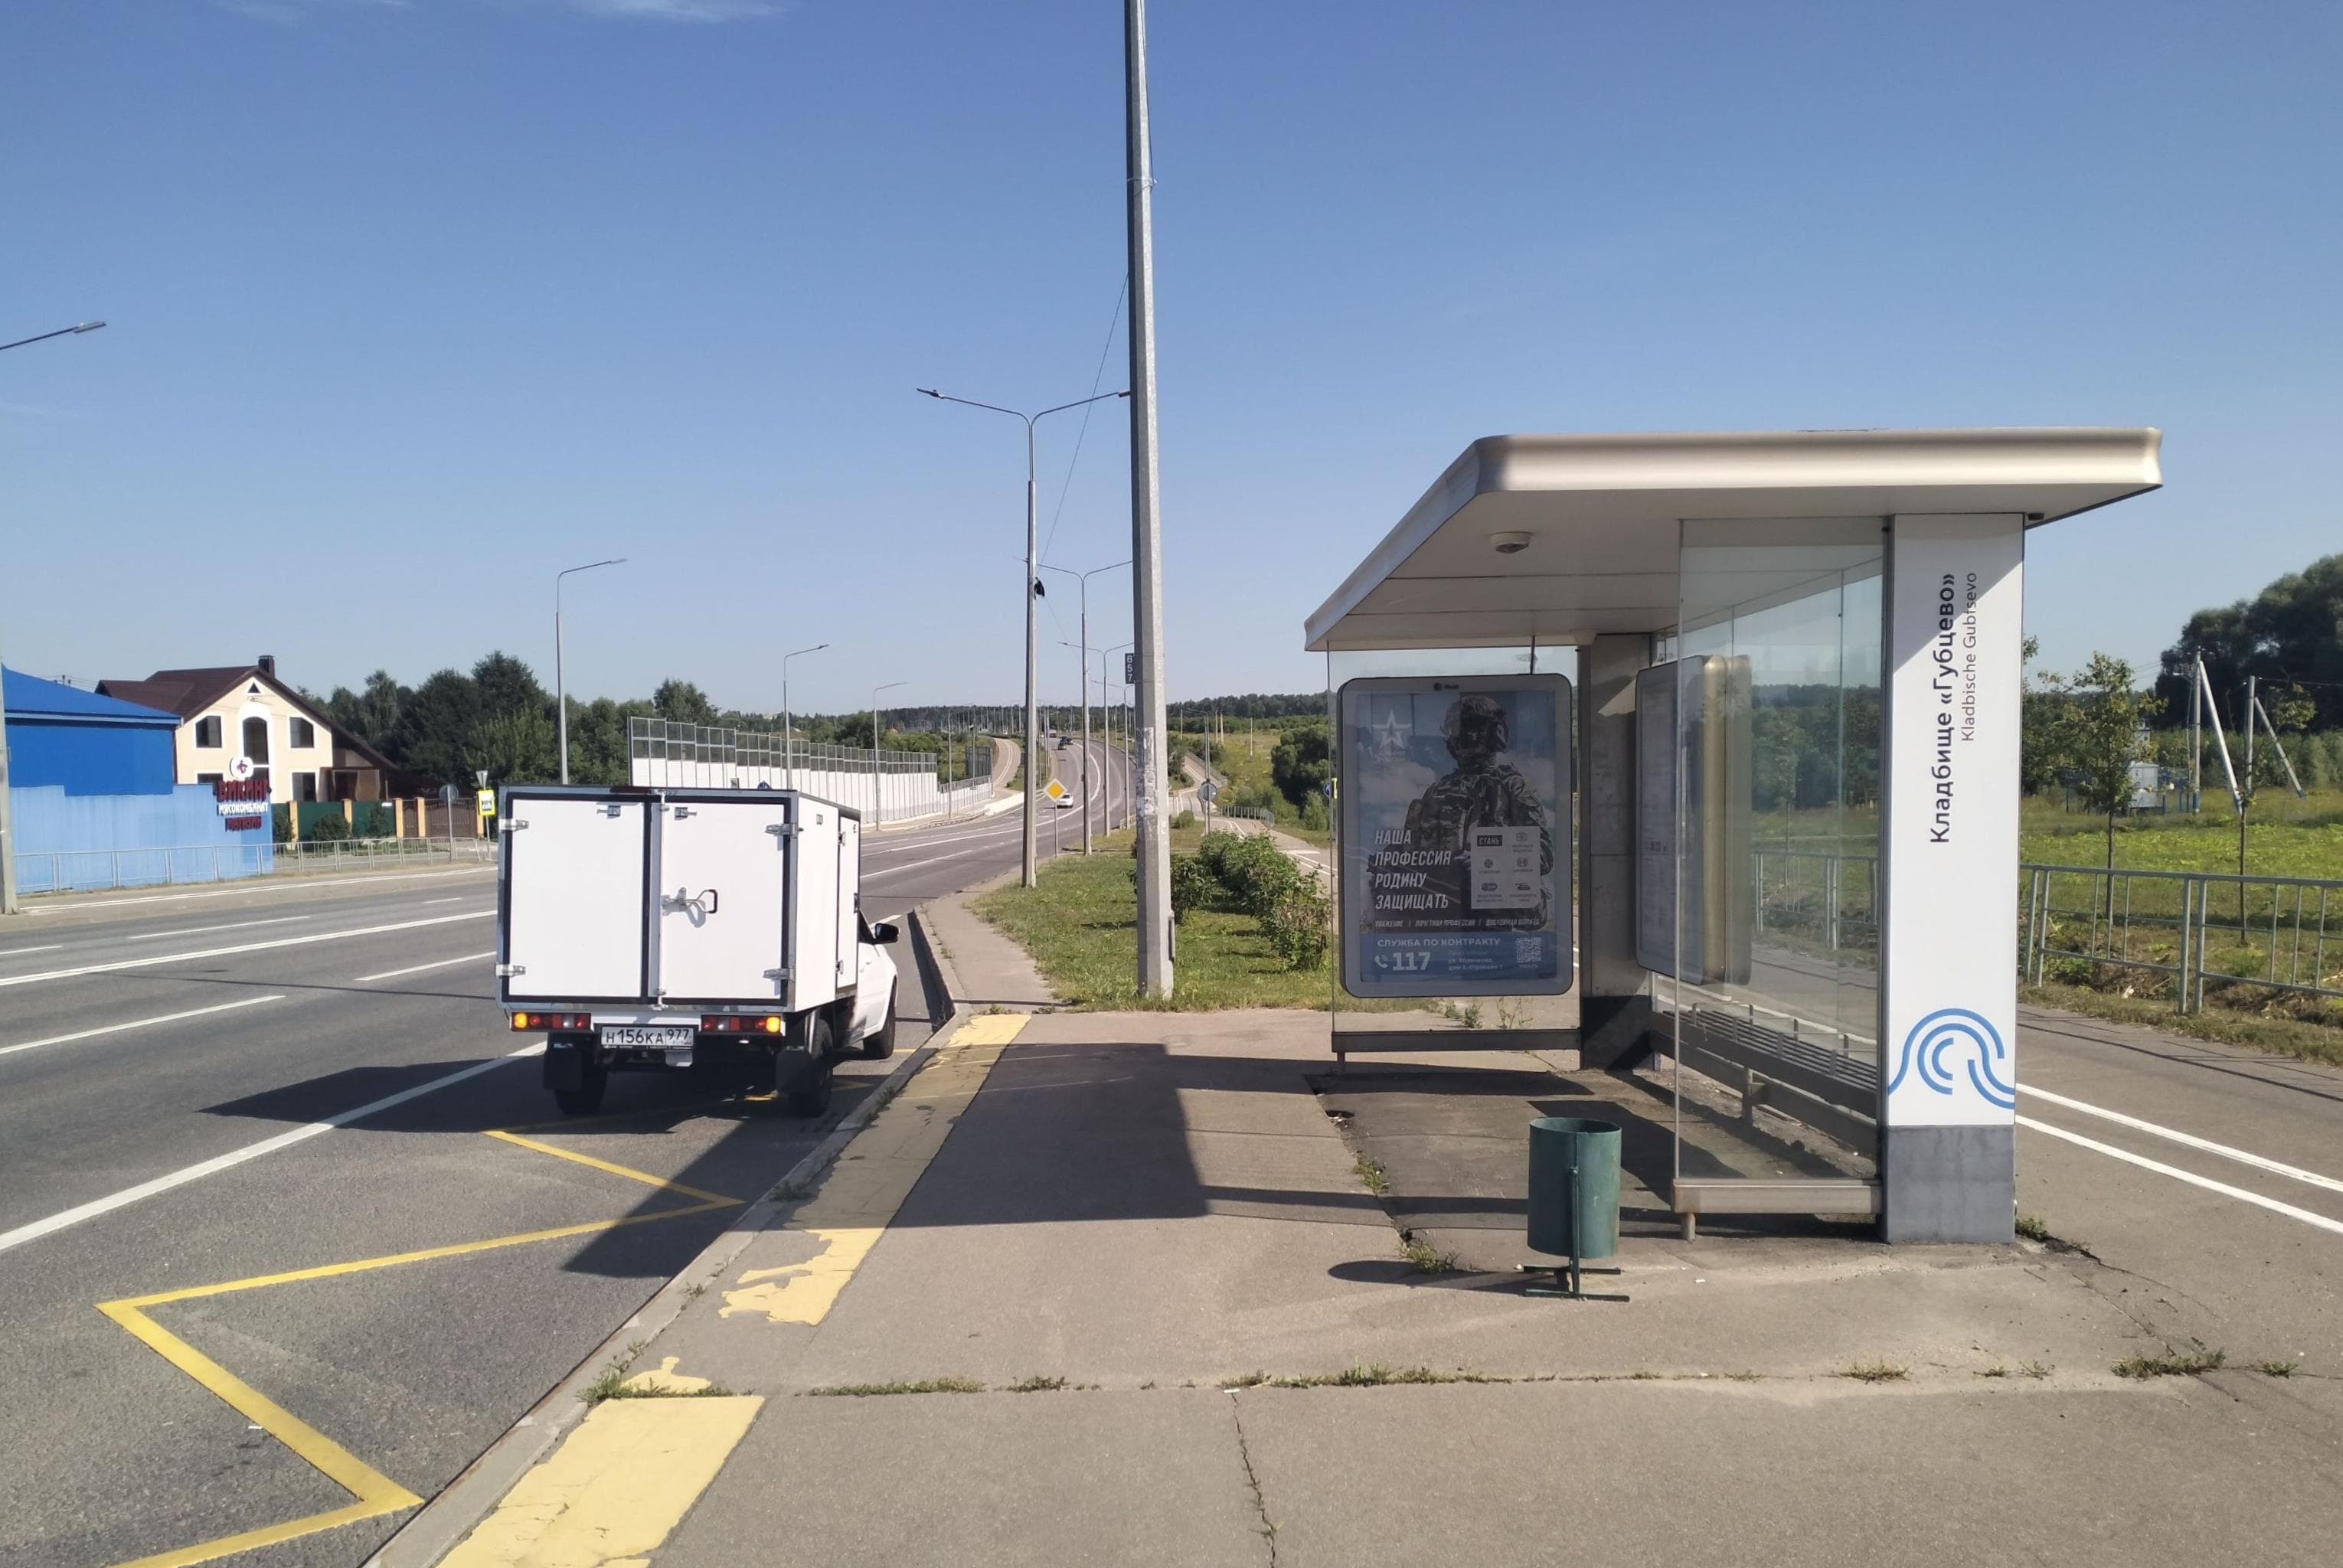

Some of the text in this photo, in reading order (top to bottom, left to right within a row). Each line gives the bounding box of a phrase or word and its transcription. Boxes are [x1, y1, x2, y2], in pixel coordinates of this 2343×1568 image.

[1961, 573, 1977, 741] Kladbische Gubtsevo
[1930, 573, 1959, 843] Кладбище «Губцево»
[1375, 830, 1411, 844] НАША
[1373, 851, 1452, 866] ПРОФЕССИЯ
[1375, 872, 1427, 889] РОДИНУ
[1375, 893, 1449, 911] ЗАЩИЩАТЬ
[1377, 939, 1420, 947] СЛУЖБА
[1441, 938, 1501, 946] КОНТРАКТУ
[1393, 952, 1430, 971] 117
[606, 1029, 689, 1044] Н156КА 977
